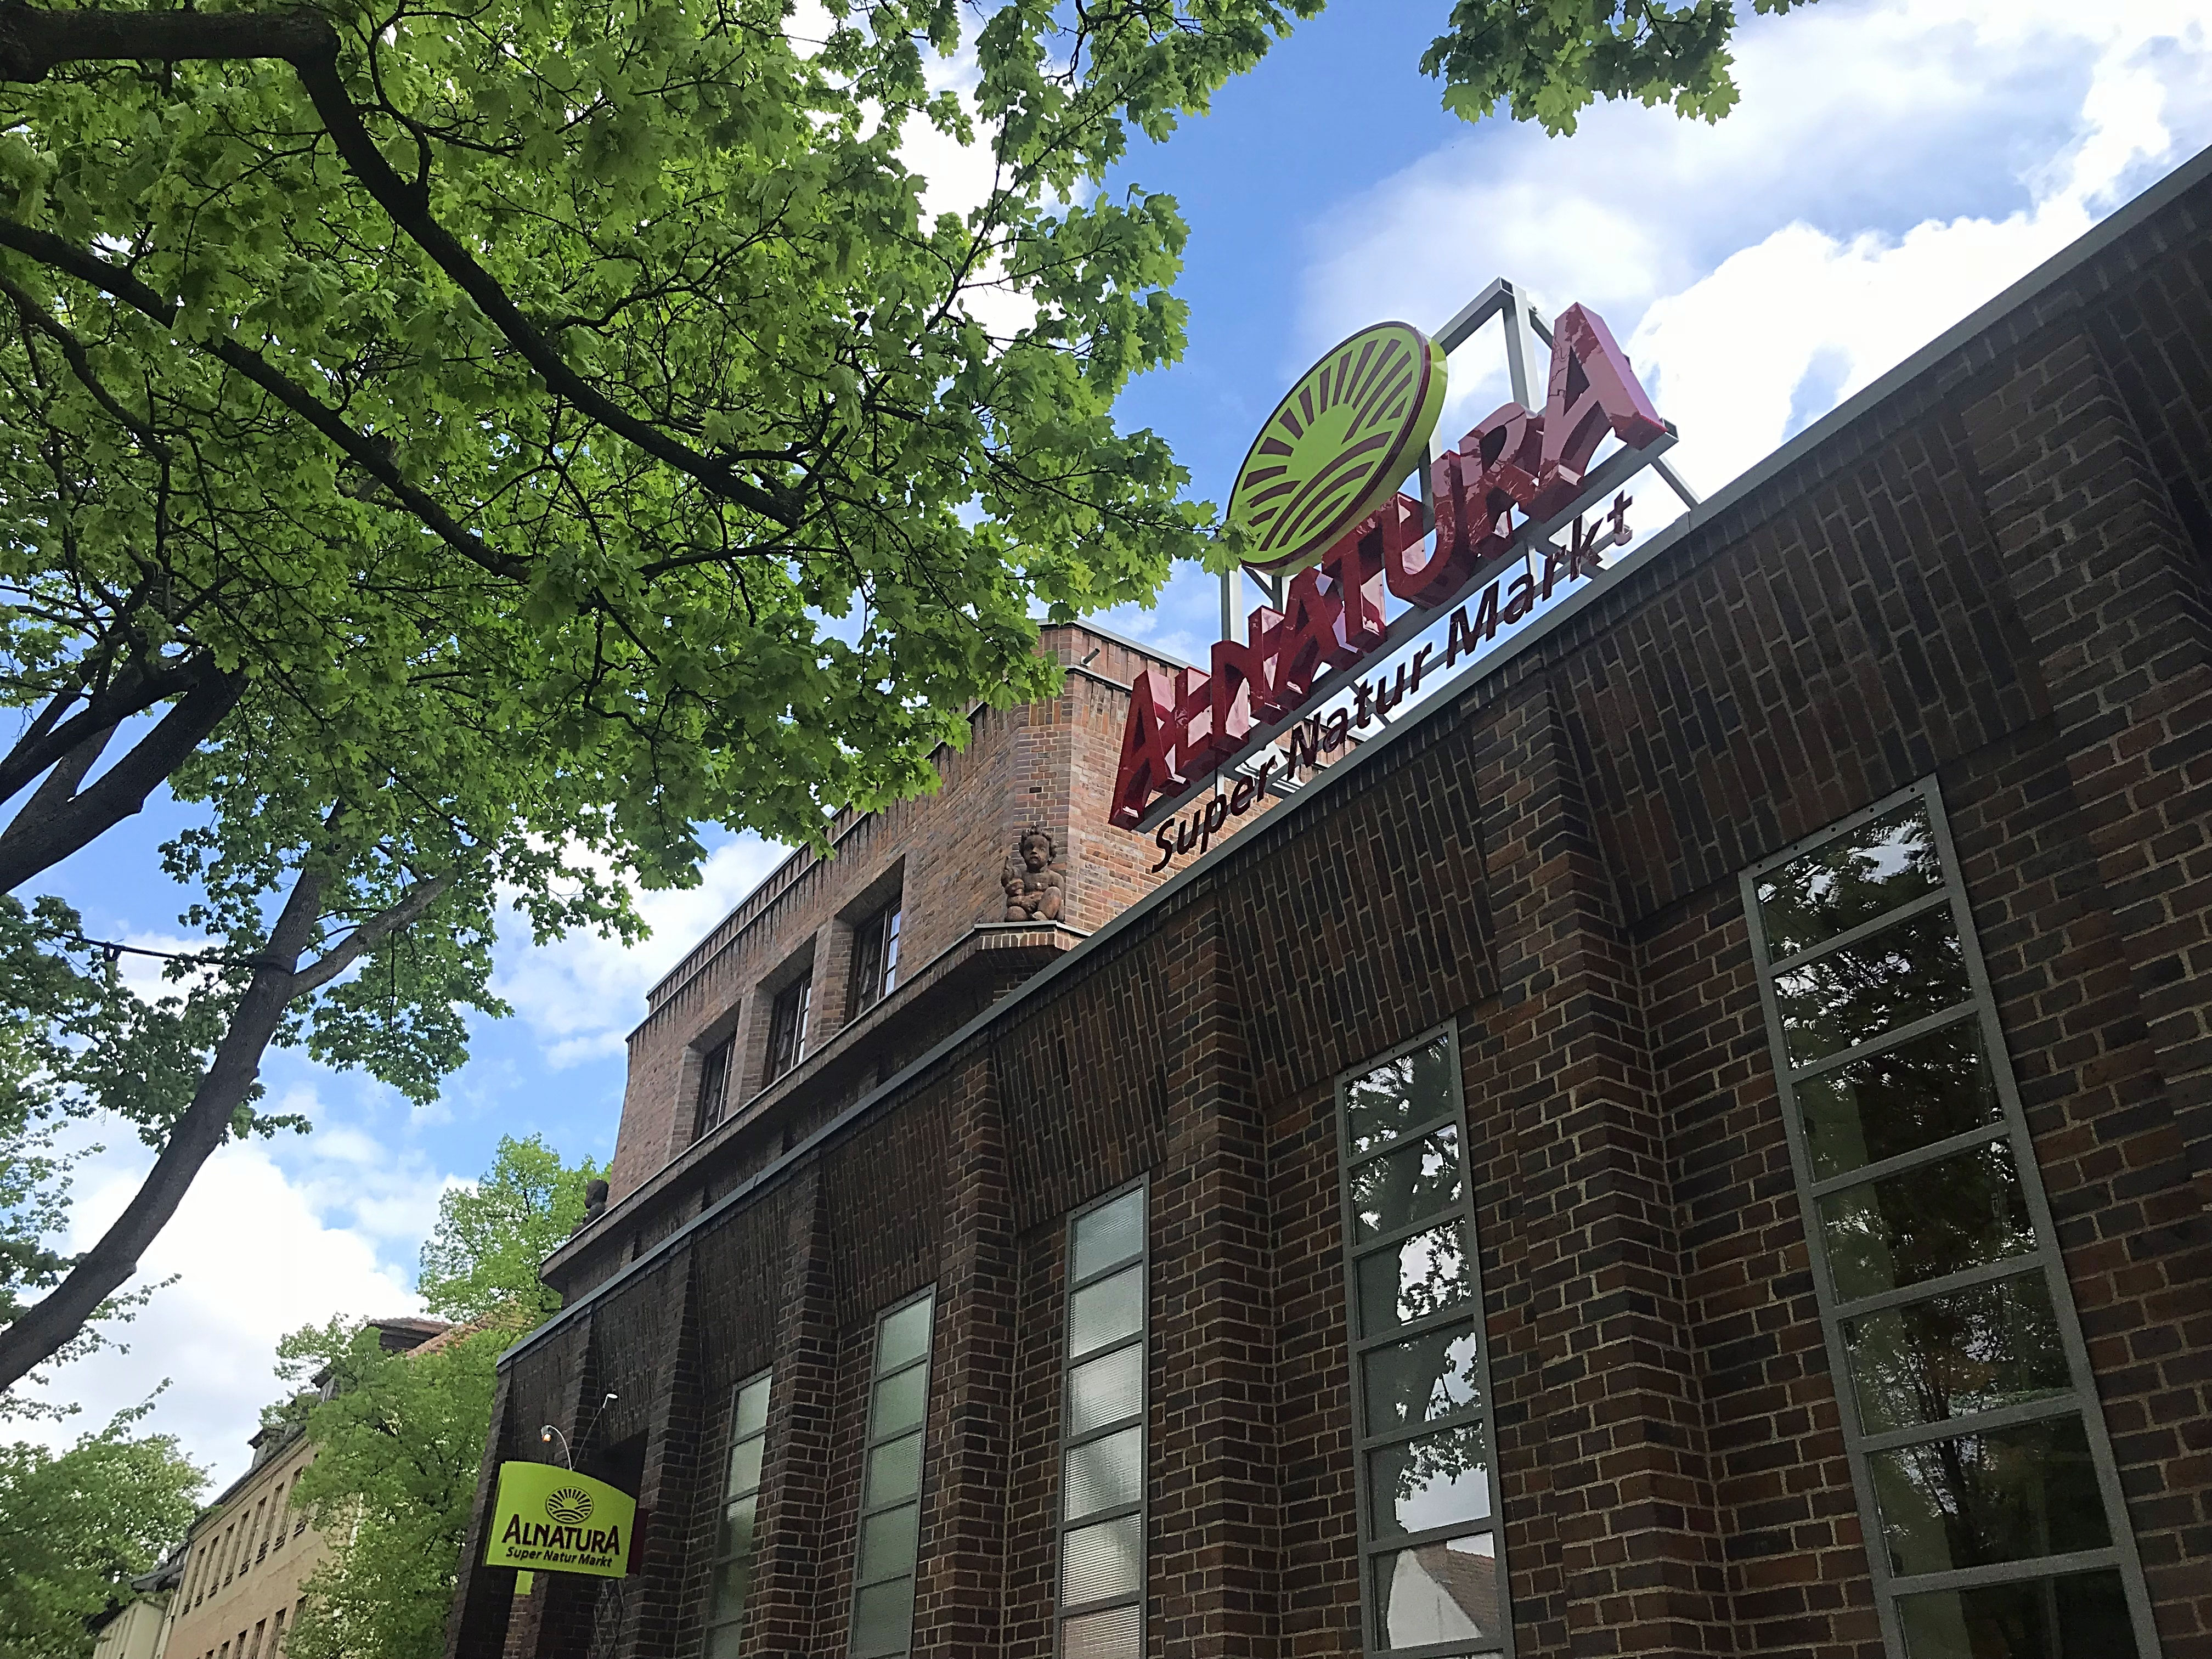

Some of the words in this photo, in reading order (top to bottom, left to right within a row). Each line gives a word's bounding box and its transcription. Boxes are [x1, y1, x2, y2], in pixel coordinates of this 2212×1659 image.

[1108, 301, 1668, 831] ALNATURA
[1152, 754, 1278, 873] Super
[1286, 641, 1433, 781] Natur
[1446, 489, 1633, 670] Markt
[501, 1514, 620, 1555] ALNATURA
[506, 1546, 542, 1561] Super
[543, 1550, 577, 1564] Natur
[578, 1553, 613, 1568] Markt
